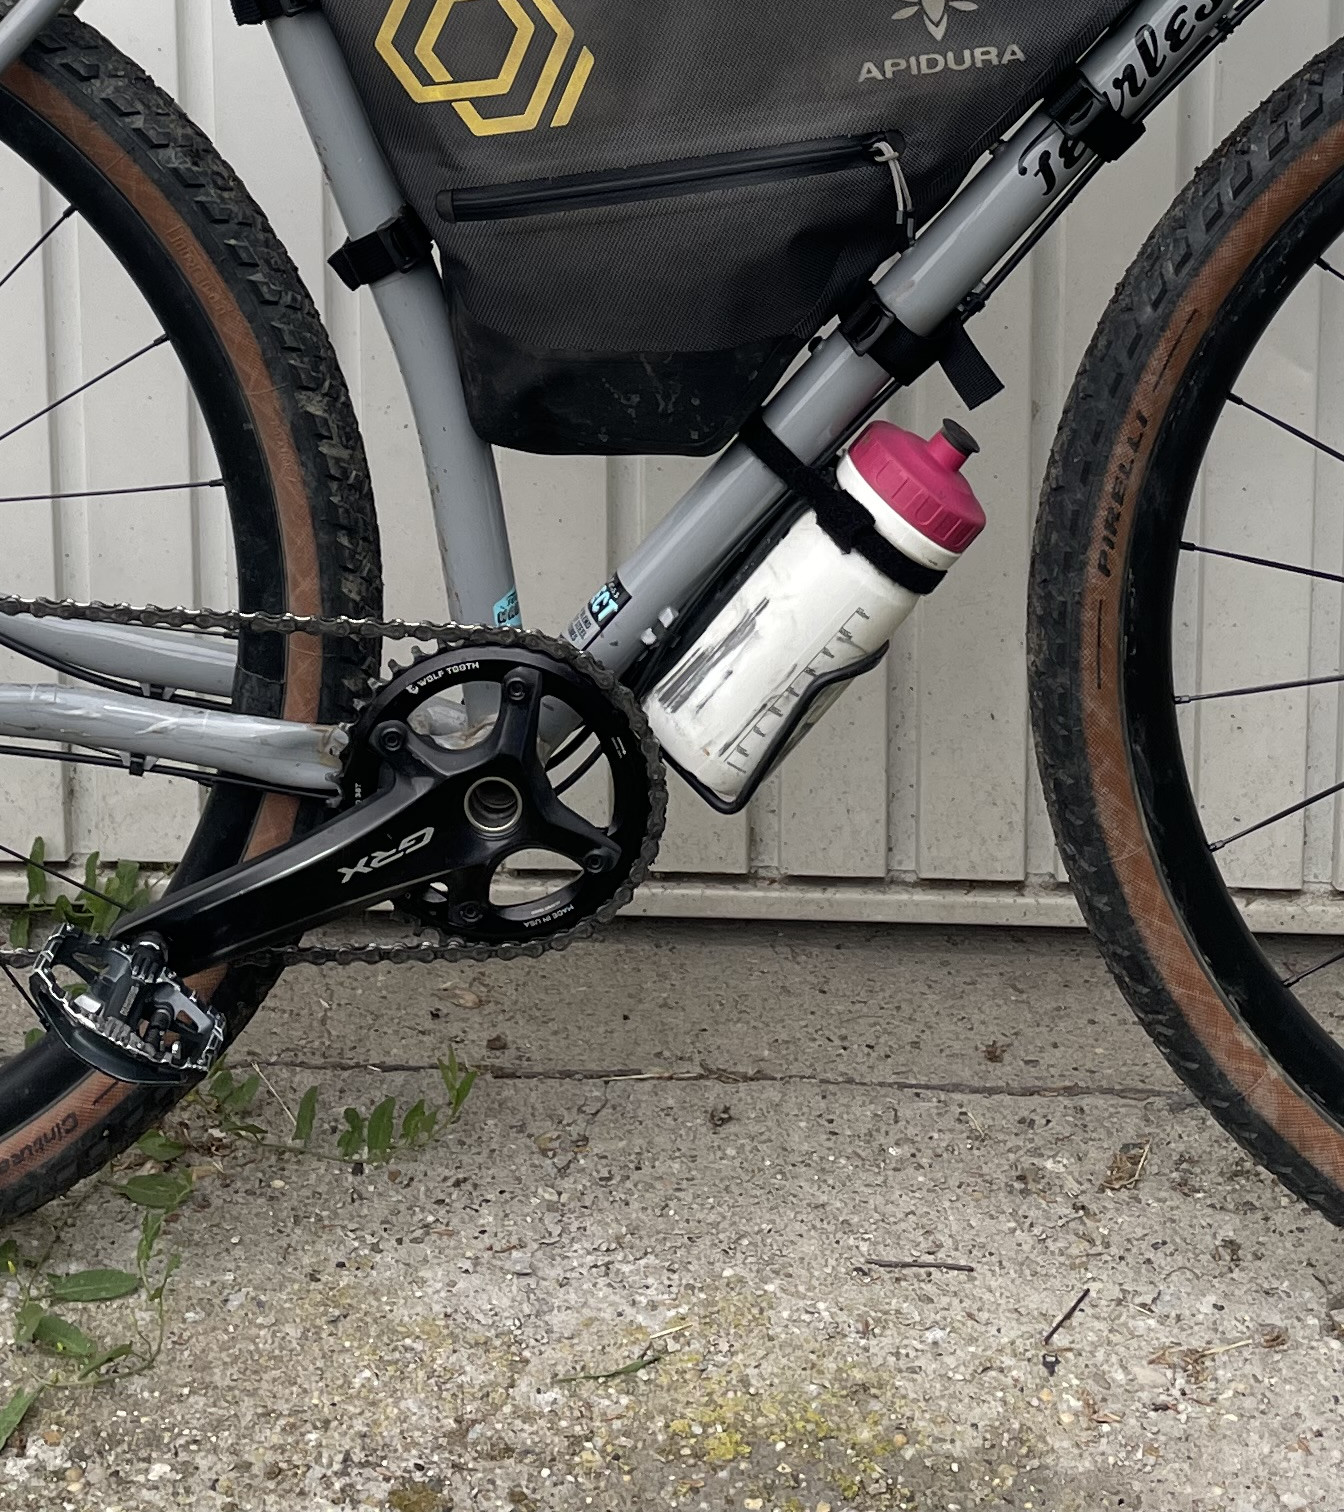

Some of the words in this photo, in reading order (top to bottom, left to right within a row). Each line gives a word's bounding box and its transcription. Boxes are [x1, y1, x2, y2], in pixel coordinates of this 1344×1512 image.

[858, 44, 1027, 82] APIDURA
[1097, 408, 1148, 578] PIRELLI
[417, 670, 444, 686] WOLF
[446, 662, 479, 674] TOOTH
[337, 827, 435, 884] GRX
